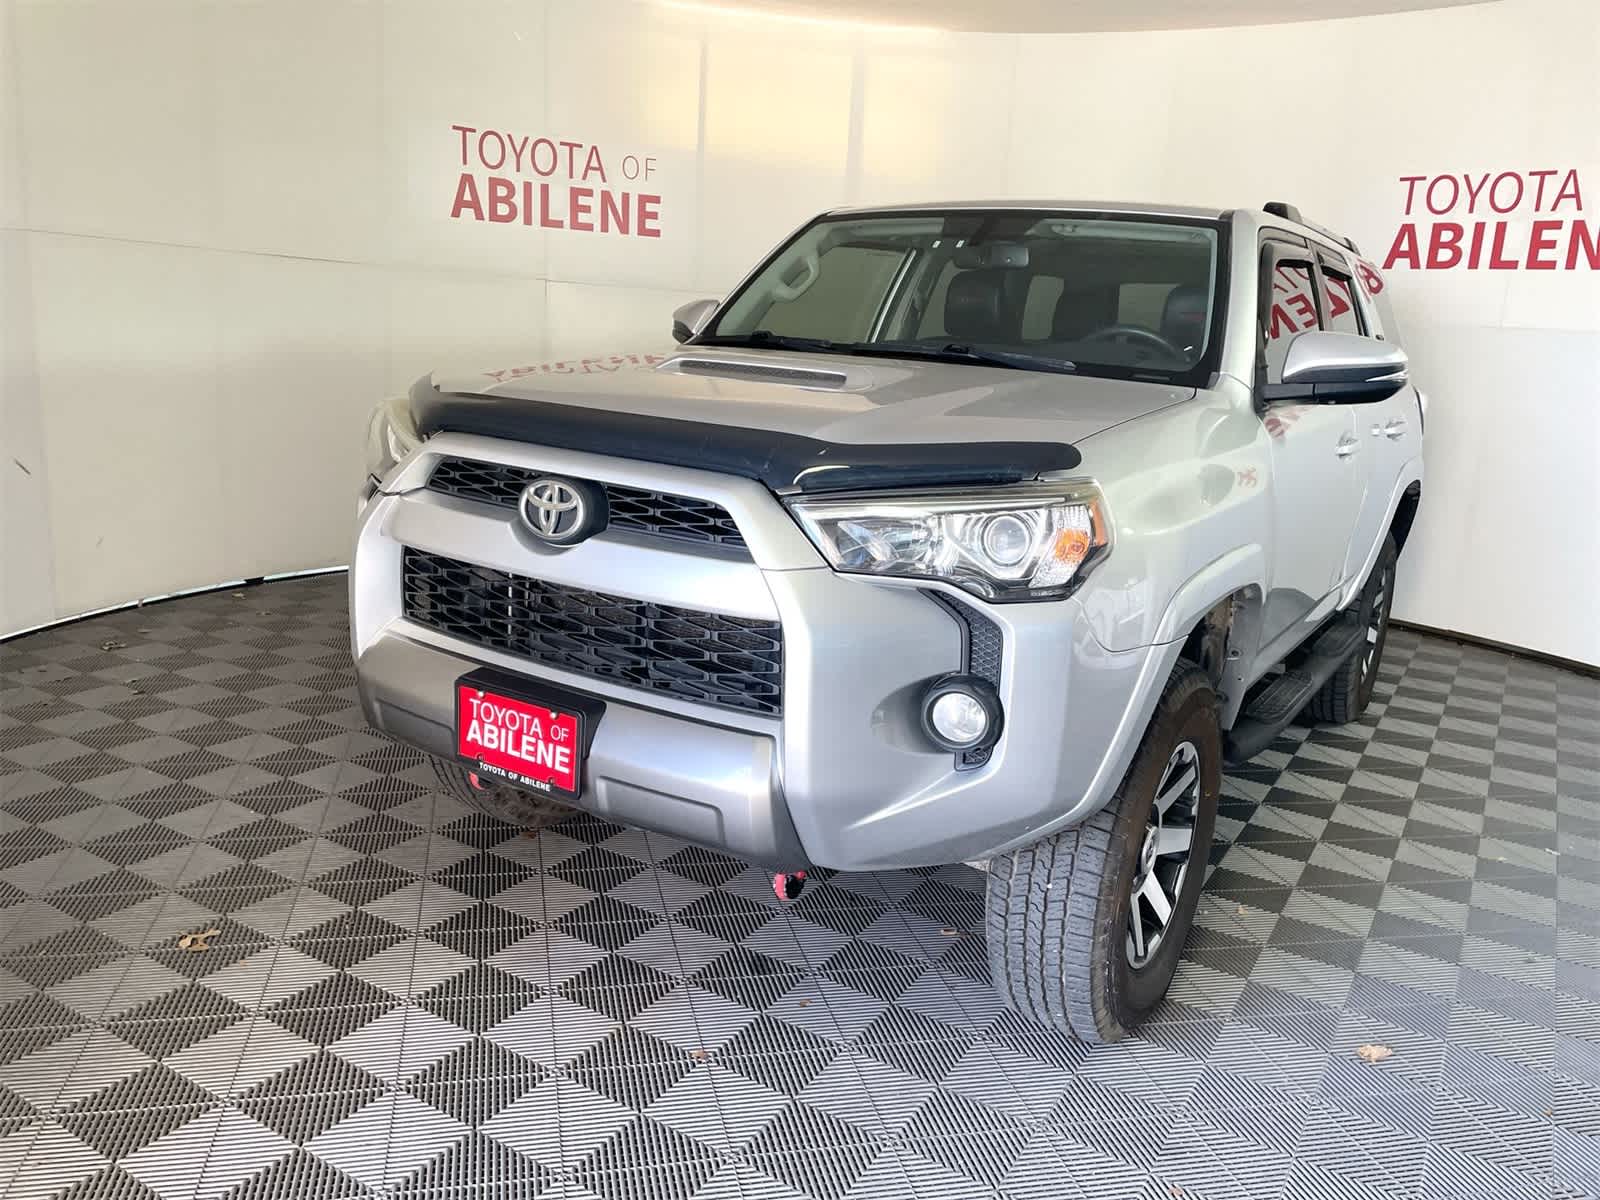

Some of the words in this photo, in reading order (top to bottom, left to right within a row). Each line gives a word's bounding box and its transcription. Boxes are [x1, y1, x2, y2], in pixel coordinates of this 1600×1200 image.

[452, 125, 607, 183] TOYOTA
[622, 155, 657, 182] OF
[451, 172, 661, 238] ABILENE
[1400, 169, 1583, 216] TOYOTA
[469, 698, 543, 740] TOYOTA
[550, 725, 569, 742] OF
[466, 719, 571, 775] ABILENE
[479, 762, 506, 777] TOYOTA
[508, 771, 519, 780] OF
[520, 775, 551, 792] ABILENE
